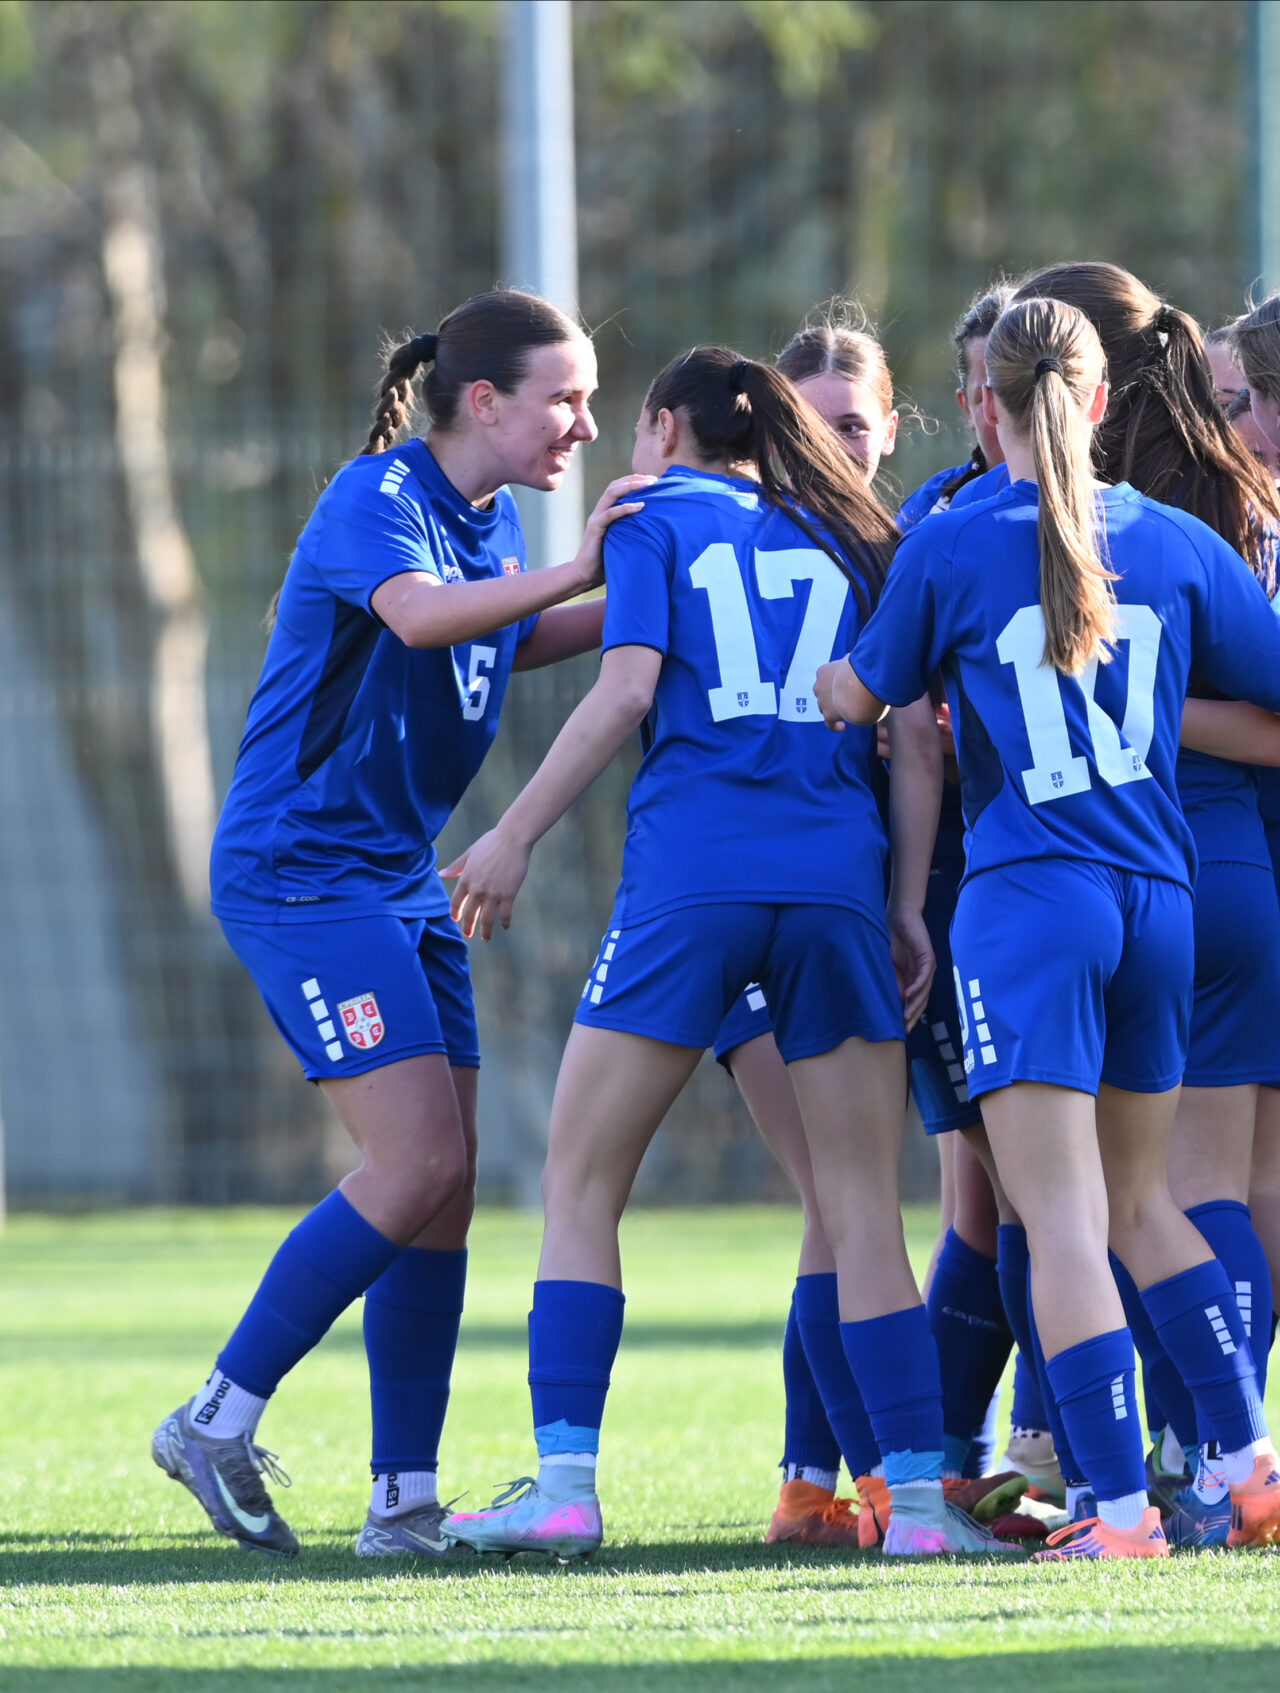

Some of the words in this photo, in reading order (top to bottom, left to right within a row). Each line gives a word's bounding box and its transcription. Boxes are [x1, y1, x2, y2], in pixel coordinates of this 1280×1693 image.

[463, 644, 497, 721] 5
[689, 543, 850, 722] 17
[996, 604, 1163, 806] 10
